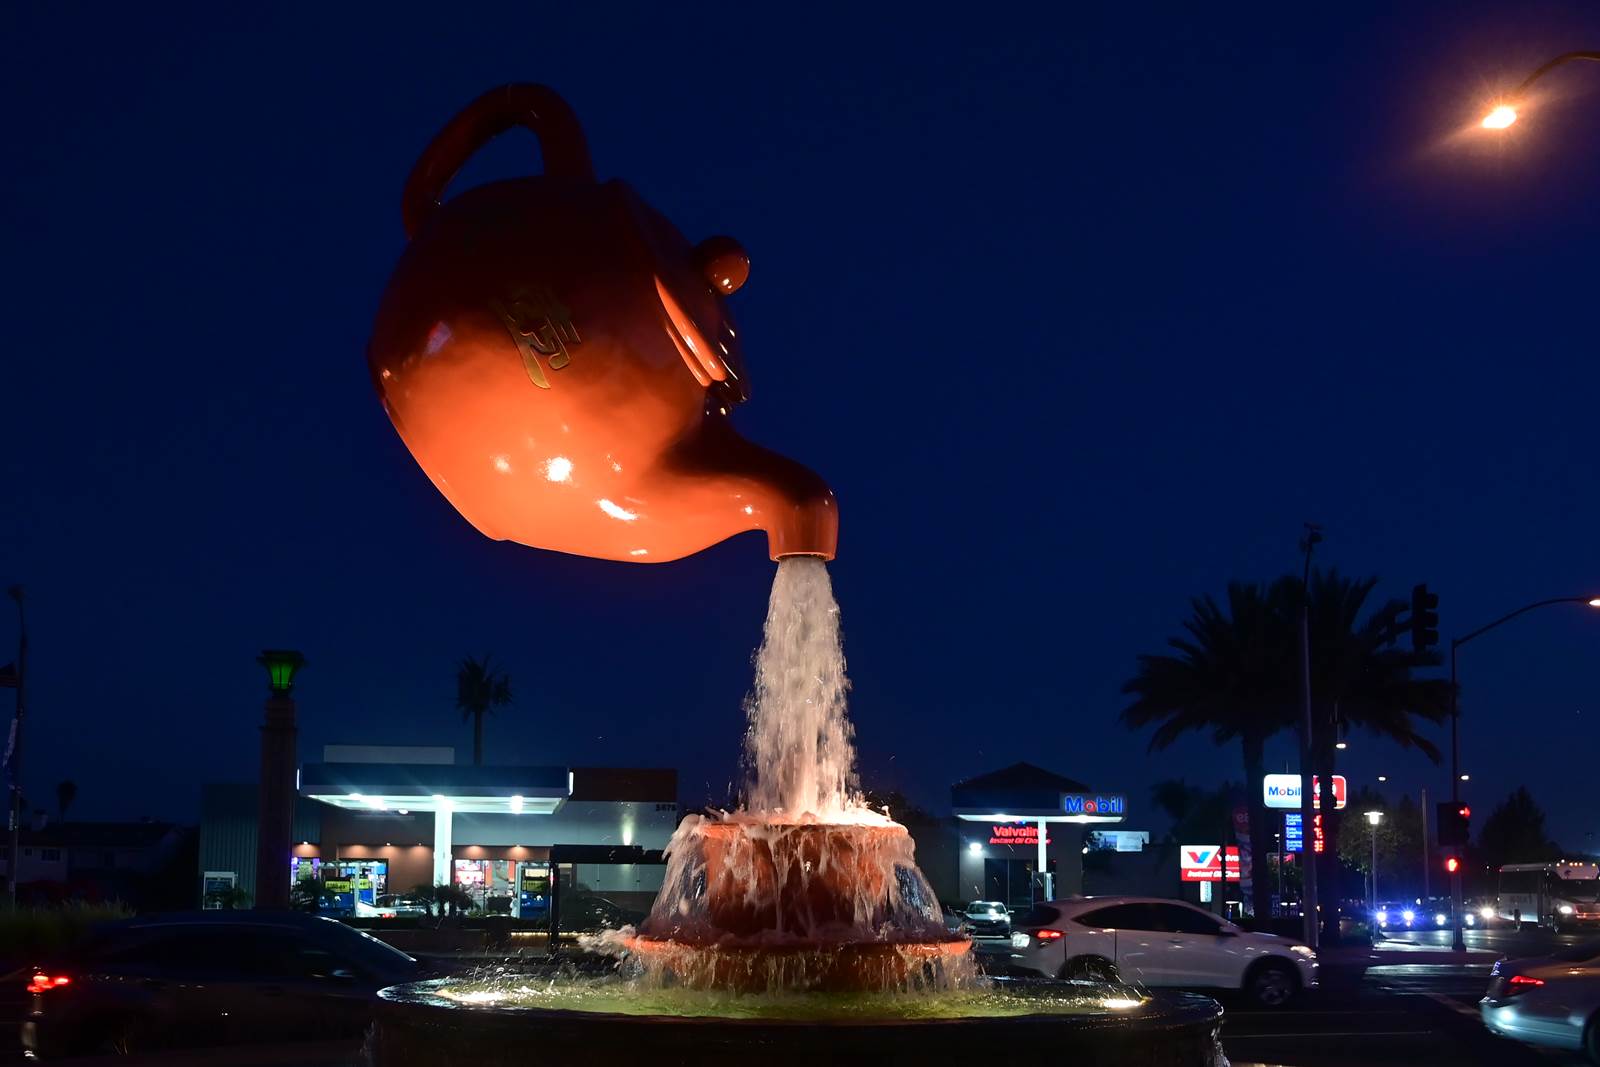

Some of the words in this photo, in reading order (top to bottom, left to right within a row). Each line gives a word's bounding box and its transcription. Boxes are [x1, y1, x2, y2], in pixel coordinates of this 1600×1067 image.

[1268, 786, 1301, 796] Mobil
[1065, 796, 1123, 813] Mobil
[993, 826, 1047, 837] Valvolin
